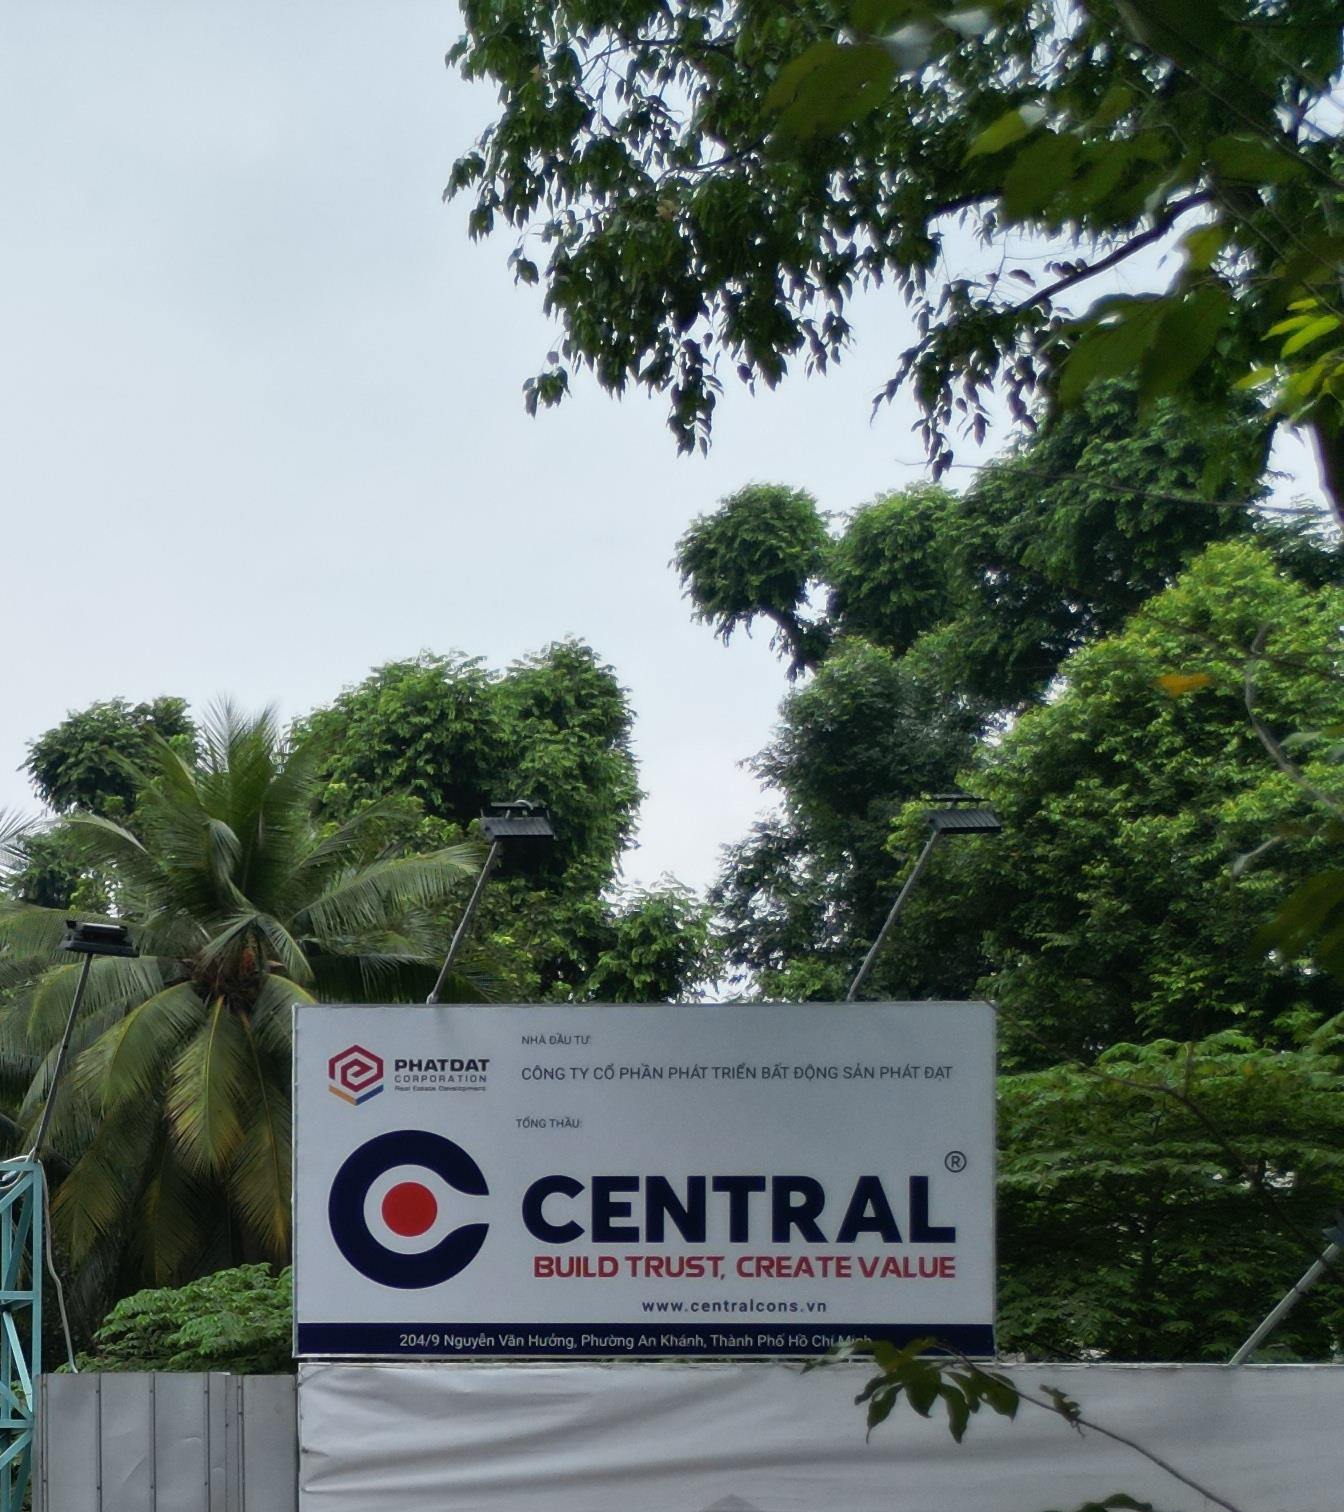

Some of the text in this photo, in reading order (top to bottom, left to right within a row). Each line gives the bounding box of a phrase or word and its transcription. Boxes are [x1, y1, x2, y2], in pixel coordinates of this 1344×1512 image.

[394, 1059, 490, 1072] PHATDAT
[521, 1063, 953, 1082] CÔNG TY CỔ PHẦN PHÁT TRIỂN BẤT ĐỘNG SẢN PHÁT ĐẠT
[394, 1074, 487, 1083] CORPORATION
[522, 1175, 956, 1243] CENTRAL
[534, 1256, 956, 1280] BUILD TRUST, CREATE VALUE
[642, 1299, 827, 1312] www.centralcons.vn
[400, 1335, 439, 1347] 204/9
[444, 1333, 495, 1349] Nguyễn
[499, 1334, 524, 1347] Văn
[582, 1334, 633, 1349] Phường
[638, 1335, 657, 1347] An
[661, 1334, 707, 1349] Khánh,
[710, 1334, 753, 1347] Thành
[758, 1334, 785, 1347] Phố
[789, 1334, 807, 1347] Hồ
[812, 1334, 834, 1347] Chí
